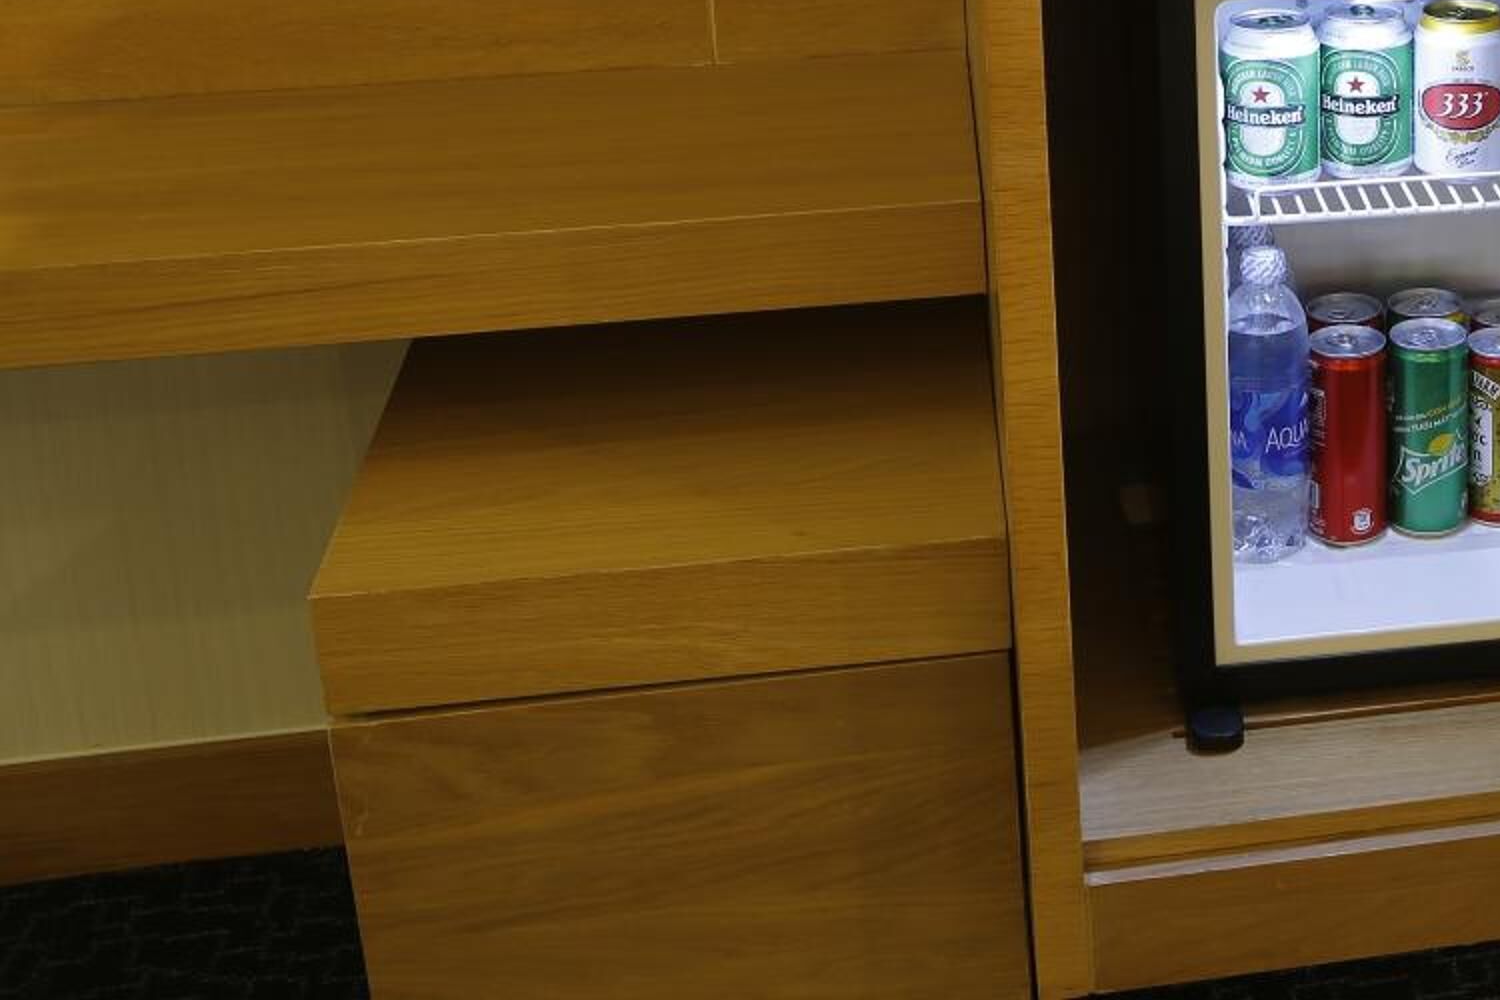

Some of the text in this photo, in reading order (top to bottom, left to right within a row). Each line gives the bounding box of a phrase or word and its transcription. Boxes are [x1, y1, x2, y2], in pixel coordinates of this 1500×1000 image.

[1322, 93, 1397, 114] Heineken
[1433, 91, 1484, 119] 333
[1227, 105, 1302, 125] Heineken
